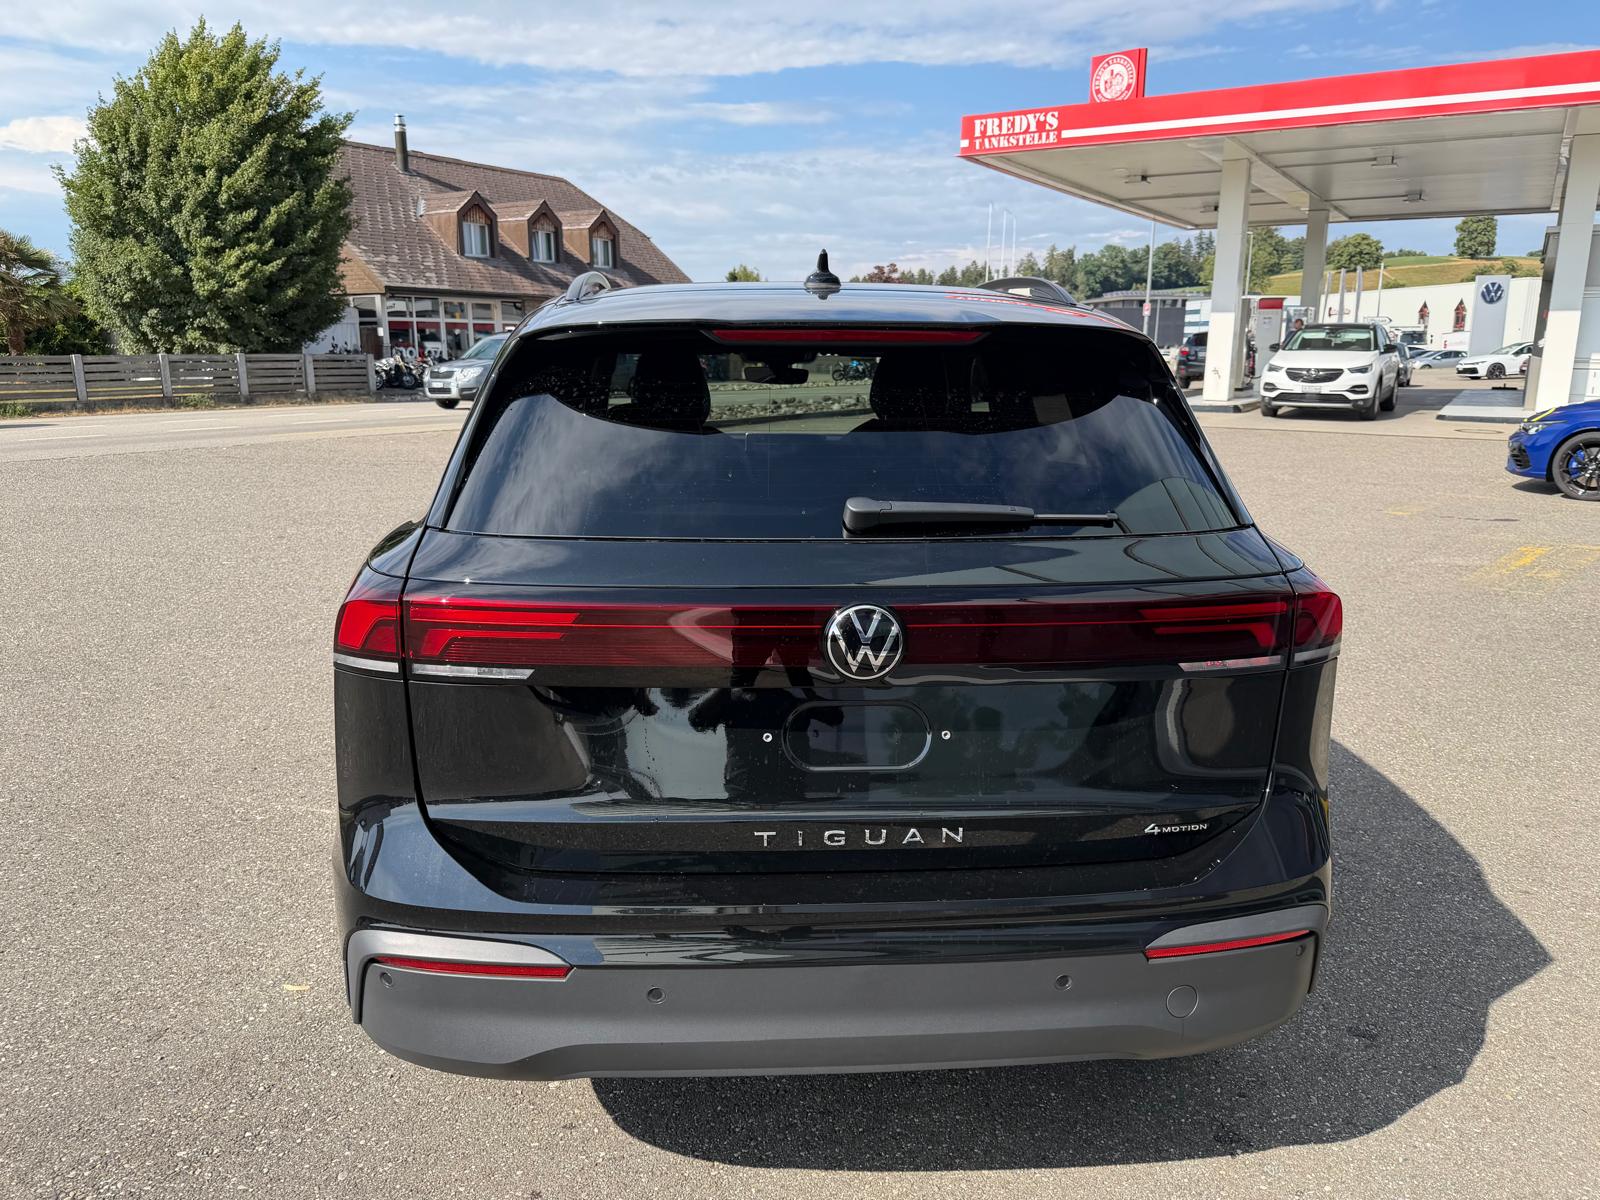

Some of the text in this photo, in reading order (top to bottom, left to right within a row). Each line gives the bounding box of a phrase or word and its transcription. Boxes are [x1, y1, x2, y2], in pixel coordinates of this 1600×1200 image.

[973, 111, 1059, 137] FREDY'S
[973, 131, 1058, 150] TANKSTELLE
[753, 826, 964, 847] TIGUAN
[1143, 823, 1209, 836] 4MOTION
